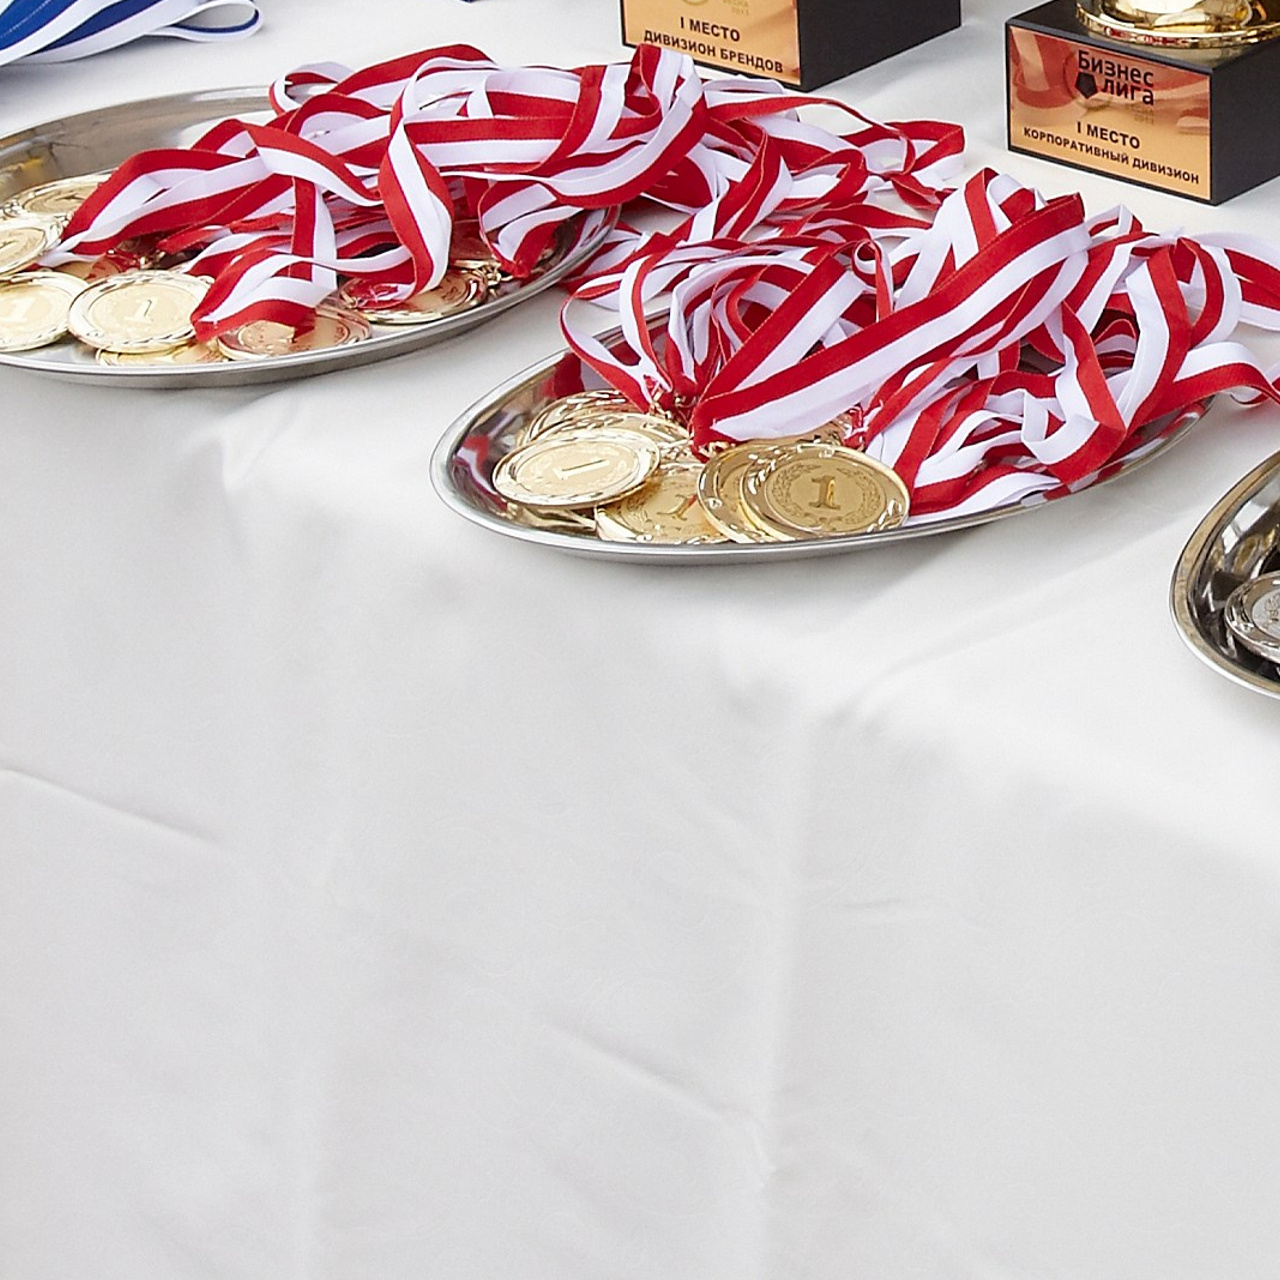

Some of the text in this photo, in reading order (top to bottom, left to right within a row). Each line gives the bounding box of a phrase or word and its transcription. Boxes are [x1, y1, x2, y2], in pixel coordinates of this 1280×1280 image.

[689, 18, 740, 42] МЕСТО
[644, 30, 783, 73] ДИВИЗИОН БРЕНДОВ
[1078, 49, 1154, 88] Бизнес
[1102, 79, 1154, 105] лига
[1086, 124, 1140, 149] МЕСТО
[1023, 126, 1200, 185] КОРПОРАТИВНЫЙ ДИВИЗИОН
[131, 297, 160, 322] 1
[809, 475, 841, 510] 1
